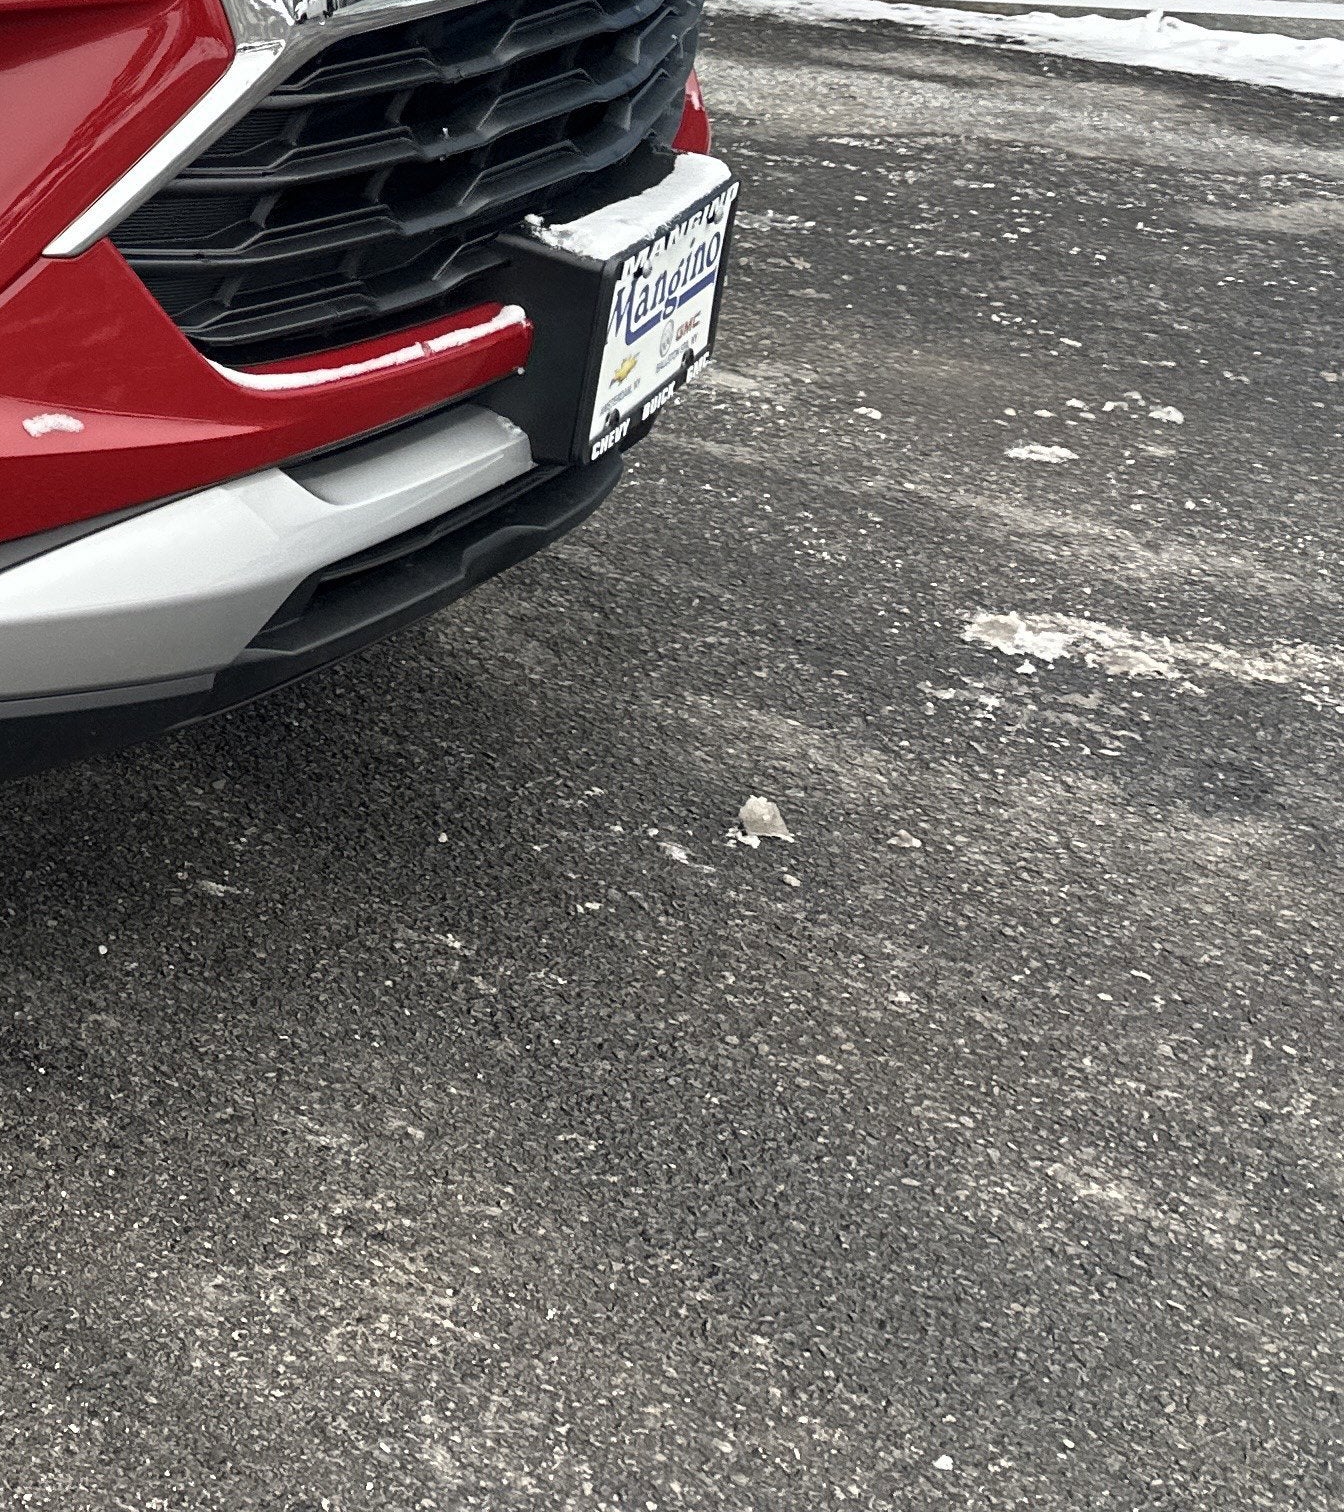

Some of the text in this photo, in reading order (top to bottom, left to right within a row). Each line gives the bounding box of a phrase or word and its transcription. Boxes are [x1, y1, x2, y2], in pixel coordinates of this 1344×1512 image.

[607, 231, 721, 346] Mangino
[675, 310, 701, 341] GMC
[591, 417, 631, 461] CHEVY
[642, 381, 676, 421] BUICK
[686, 351, 711, 384] GMC
